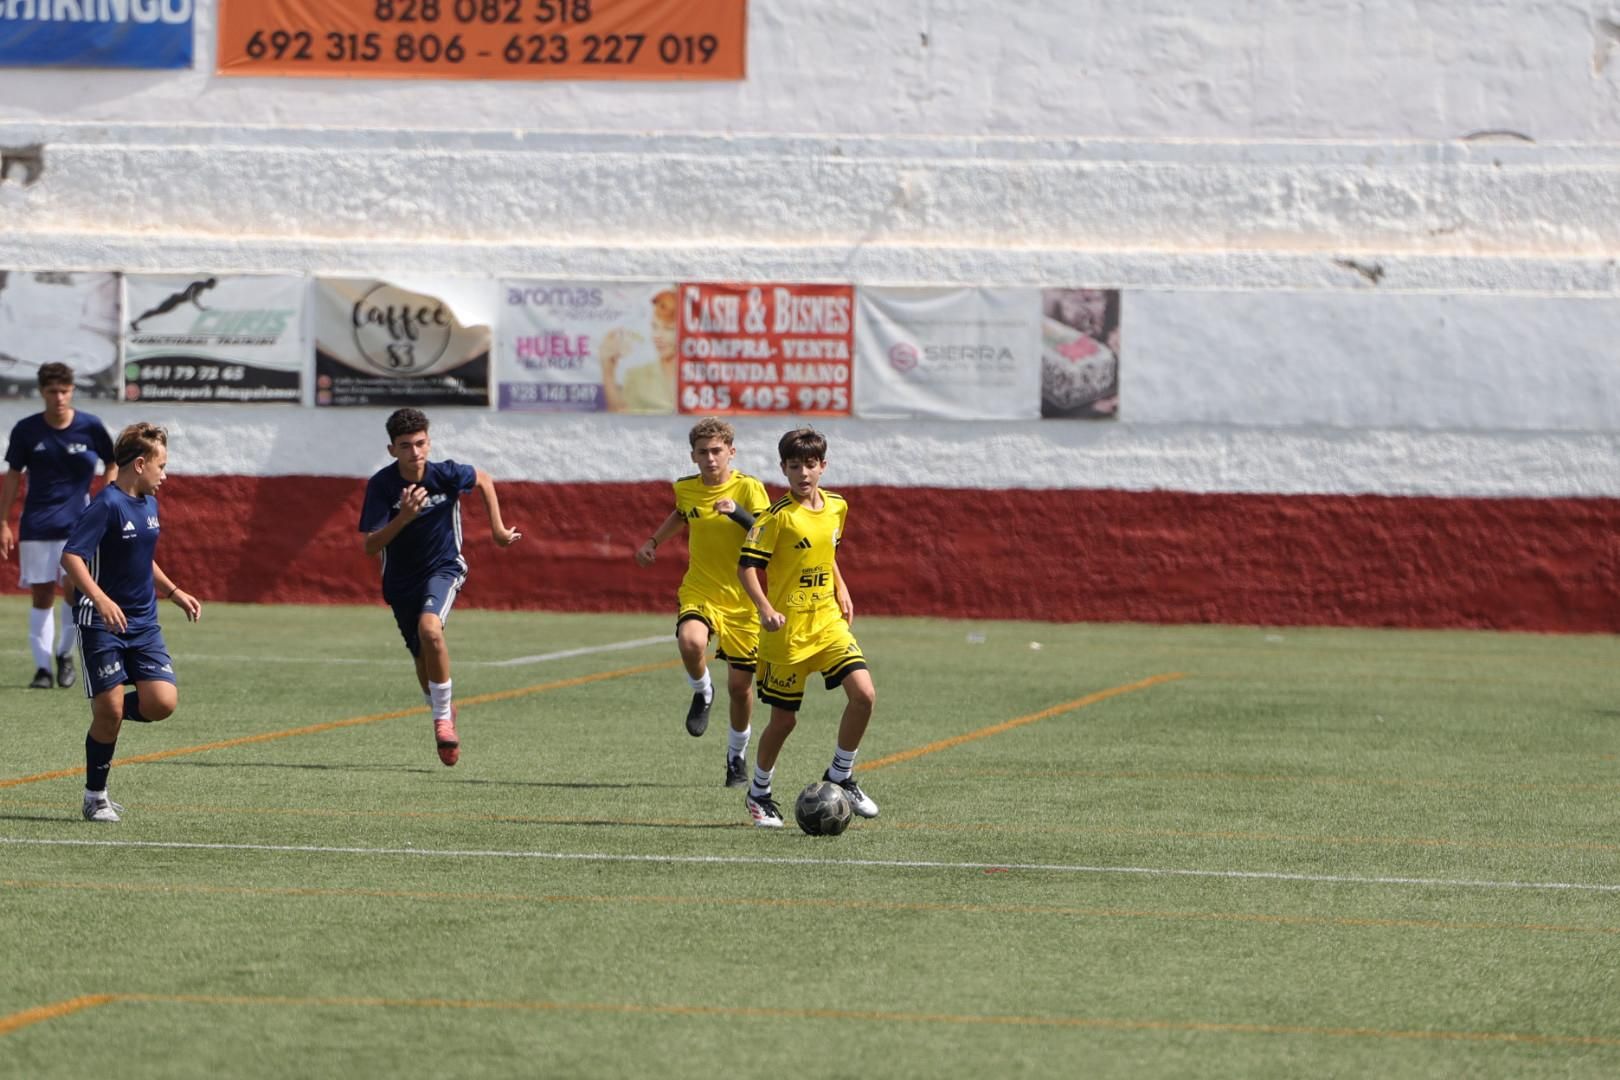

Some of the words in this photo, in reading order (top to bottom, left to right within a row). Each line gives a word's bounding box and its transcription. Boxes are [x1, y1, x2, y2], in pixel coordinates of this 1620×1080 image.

[375, 0, 440, 22] 828
[454, 0, 523, 23] 082
[535, 0, 592, 23] 518
[246, 30, 314, 61] 692
[325, 32, 382, 61] 315
[395, 33, 465, 63] 806
[503, 34, 569, 64] 623
[582, 34, 647, 64] 227
[659, 34, 719, 64] 019
[507, 287, 604, 306] aromas
[744, 286, 768, 334] &
[516, 334, 592, 358] HUELE
[781, 338, 850, 359] VENTA
[925, 344, 1015, 361] SIERRA
[681, 361, 778, 383] SEGUNDA
[782, 362, 849, 384] MANO
[682, 385, 731, 409] 685
[739, 386, 790, 410] 405
[797, 387, 849, 410] 995
